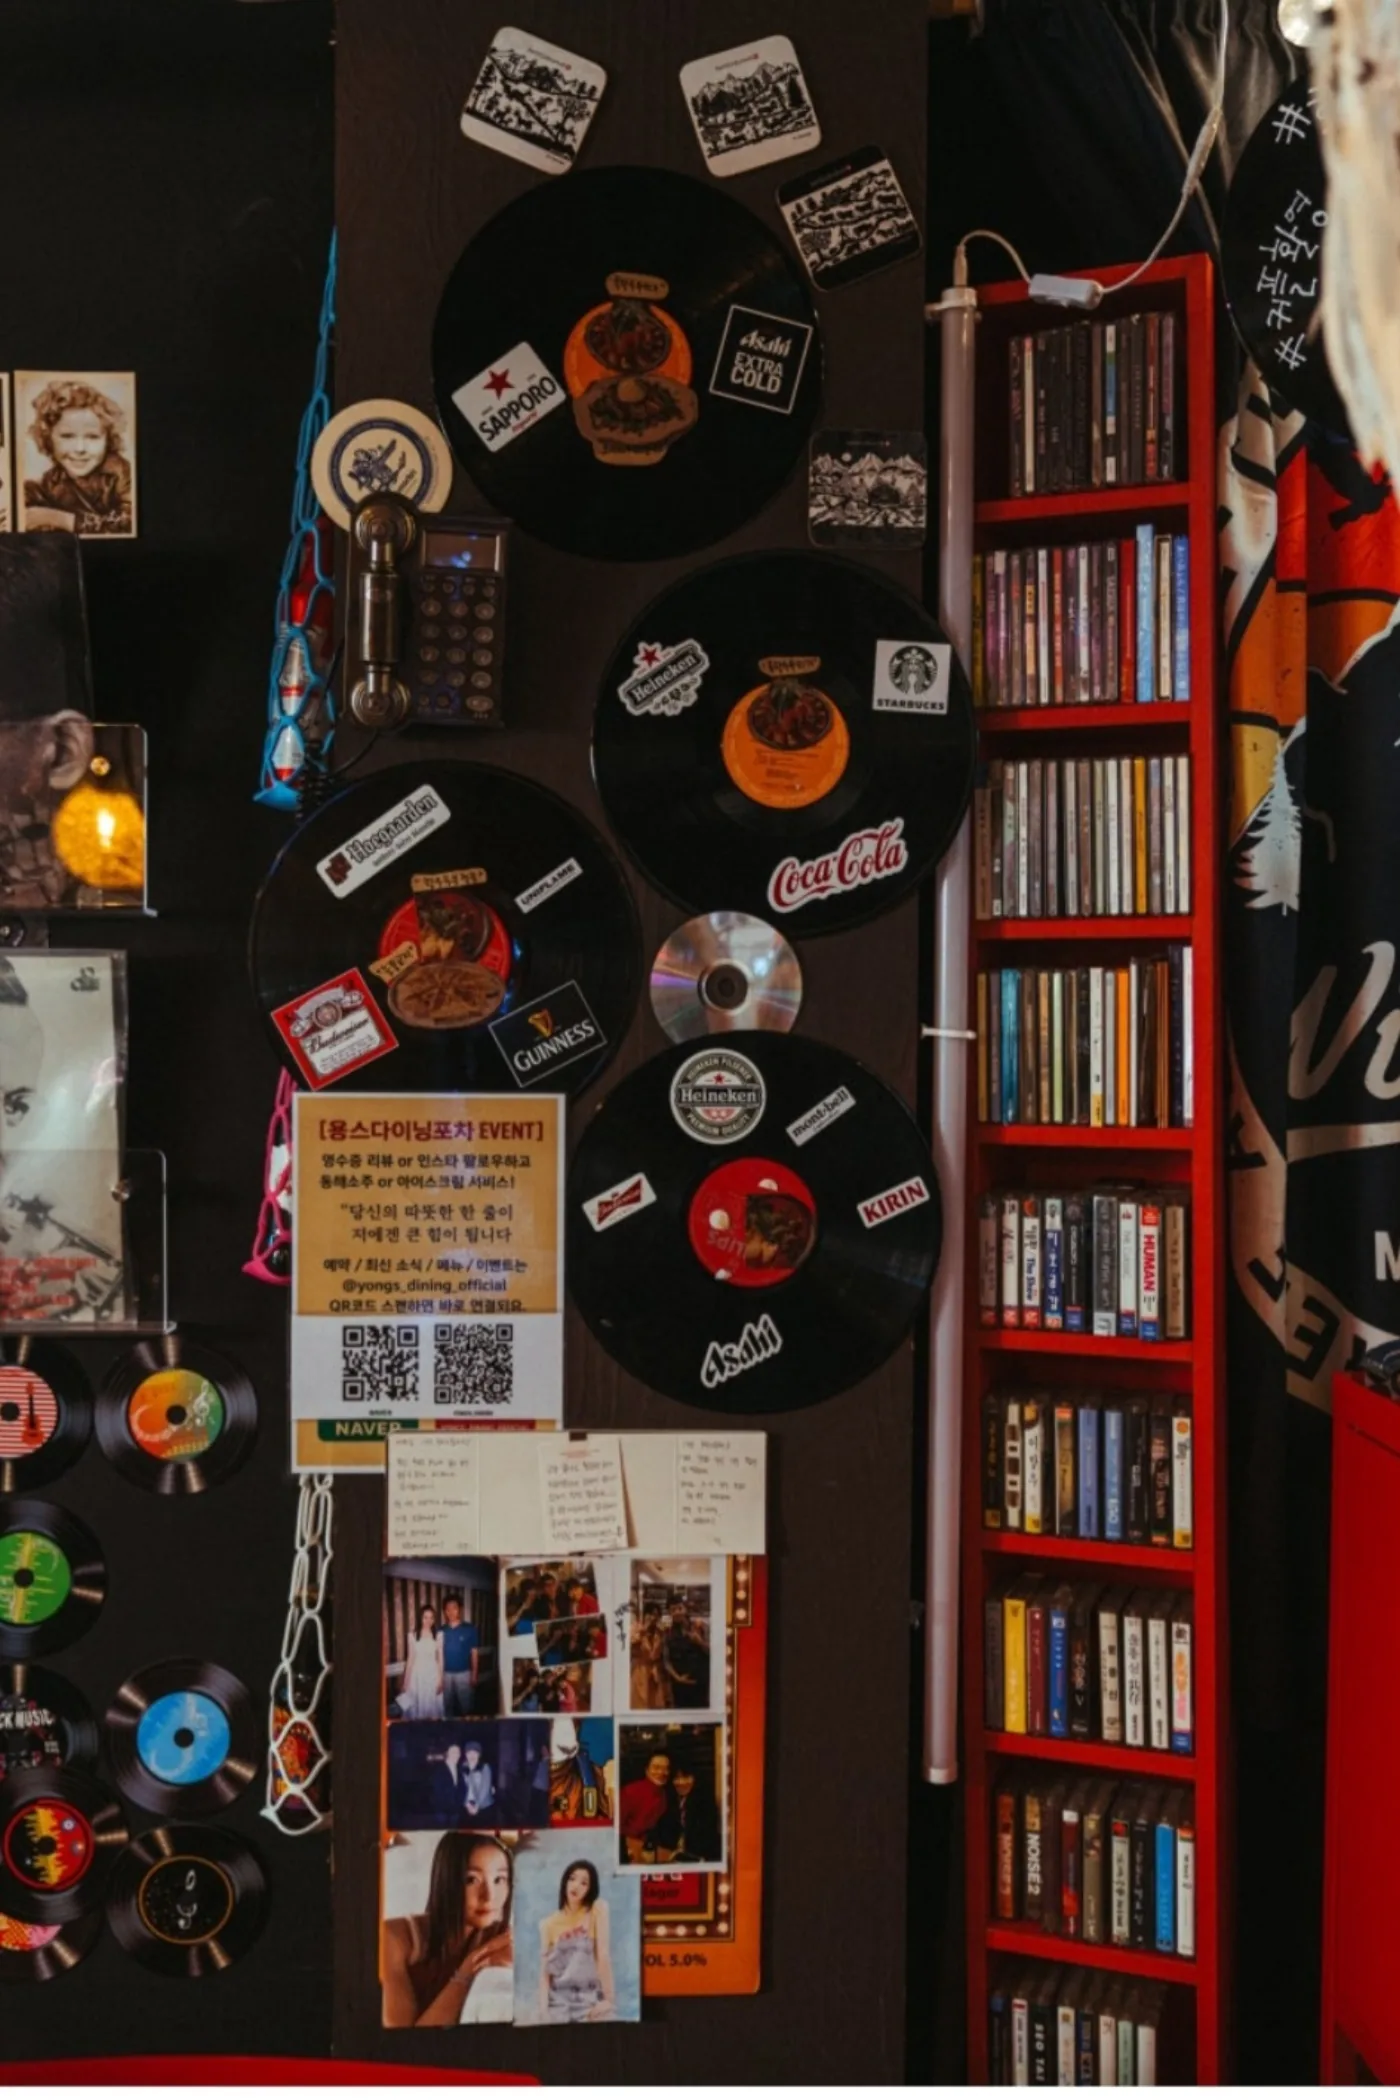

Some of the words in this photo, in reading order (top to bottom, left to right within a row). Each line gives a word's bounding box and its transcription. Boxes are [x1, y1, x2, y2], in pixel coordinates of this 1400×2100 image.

[740, 329, 792, 357] Asahi
[735, 352, 783, 377] EXTRA
[731, 367, 781, 394] COLD
[479, 376, 557, 441] SAPPORO
[631, 655, 698, 701] Heineken
[876, 697, 946, 712] STARBUCKS
[345, 795, 438, 863] Hoegaarden
[772, 823, 903, 908] Coca-Cola
[520, 862, 578, 907] UNIFLAME
[512, 1020, 597, 1073] GUINNESS
[680, 1086, 758, 1103] Heineken
[792, 1087, 850, 1138] mont-bell
[479, 1120, 544, 1142] EVENT]
[322, 1154, 361, 1168] 영수증
[367, 1153, 393, 1169] 리뷰
[398, 1156, 413, 1168] or
[417, 1154, 458, 1169] 인스타
[463, 1154, 531, 1169] 팔로우하고
[378, 1178, 393, 1189] or
[397, 1174, 464, 1190] 아이스크림
[468, 1174, 516, 1191] 서비스!
[405, 1203, 453, 1221] 따뜻한
[460, 1203, 476, 1221] 한
[483, 1203, 513, 1221] 줄이
[863, 1181, 927, 1224] KIRIN
[352, 1226, 399, 1244] 저에겐
[406, 1227, 421, 1243] 큰
[427, 1226, 458, 1244] 힘이
[465, 1226, 513, 1244] 됩니다
[323, 1258, 350, 1273] 예약
[354, 1259, 363, 1274] /
[365, 1258, 392, 1273] 최신
[396, 1258, 423, 1273] 소식
[425, 1259, 434, 1273] /
[437, 1258, 464, 1273] 메뉴
[466, 1259, 474, 1273] /
[476, 1258, 528, 1274] 이벤트는
[1142, 1234, 1157, 1293] HUMAN
[343, 1278, 507, 1295] @yongs_dining_official
[329, 1298, 377, 1313] QR코드
[381, 1298, 434, 1314] 스캔하면
[438, 1299, 465, 1314] 바로
[703, 1316, 781, 1387] Asahi
[15, 1708, 57, 1729] MUSIC
[1034, 2023, 1045, 2051] SEO
